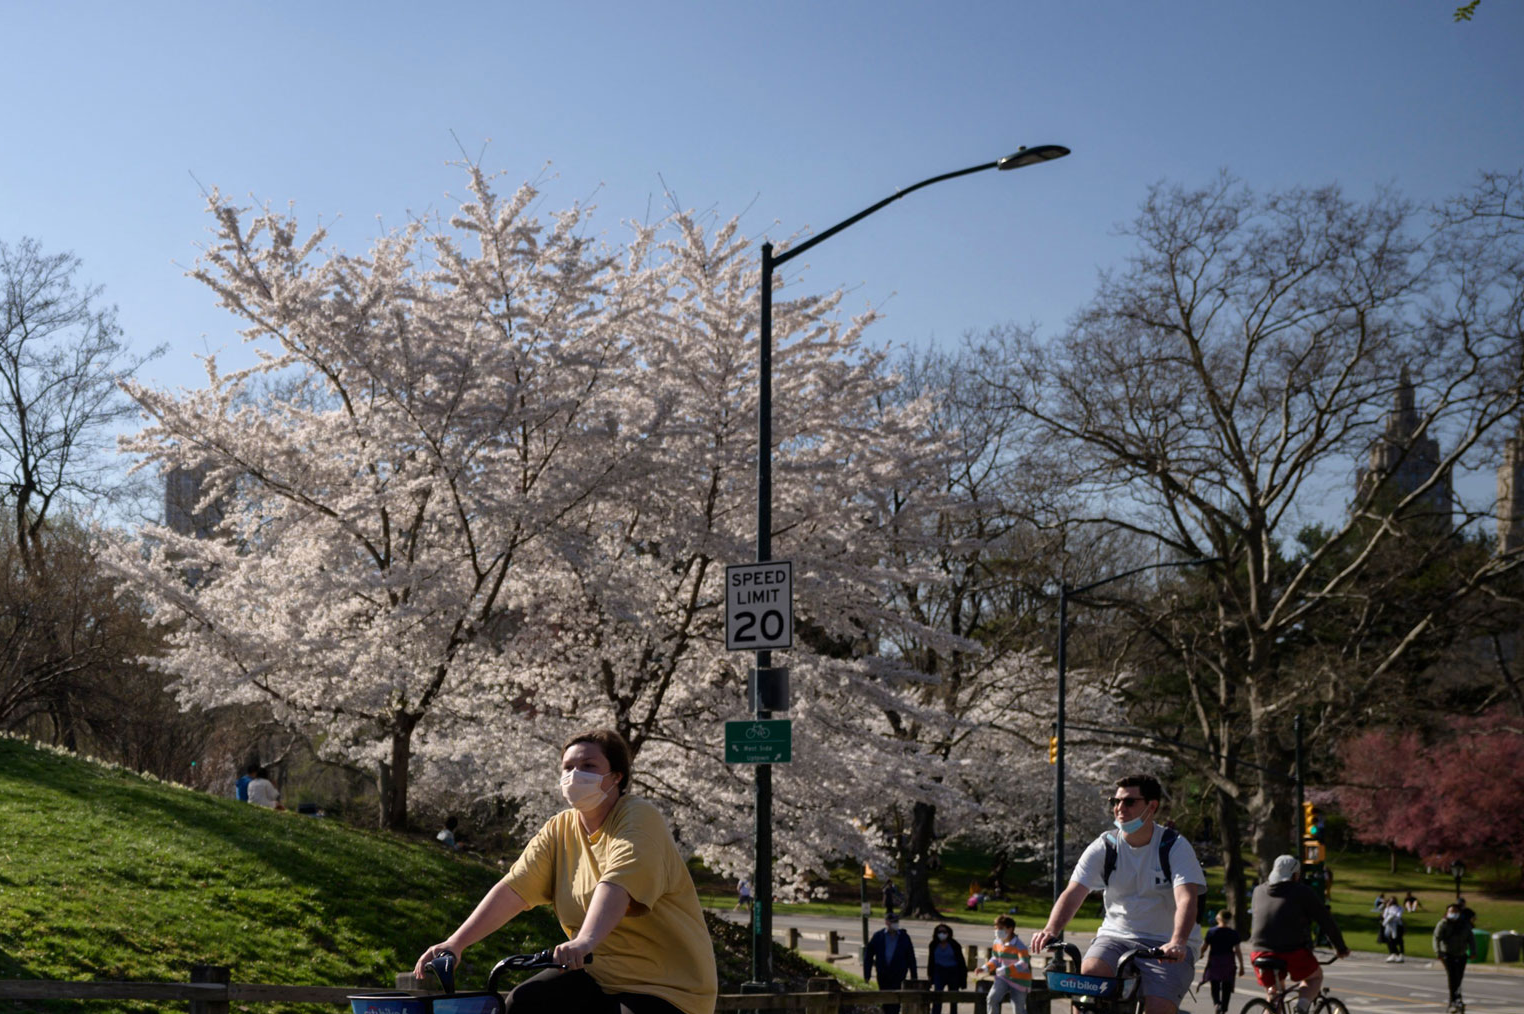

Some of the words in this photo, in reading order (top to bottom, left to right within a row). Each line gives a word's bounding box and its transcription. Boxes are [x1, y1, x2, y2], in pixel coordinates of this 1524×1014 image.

[732, 570, 786, 587] SPEED
[737, 588, 780, 605] LIMIT
[734, 609, 784, 642] 20
[1060, 978, 1076, 989] citi
[1077, 980, 1099, 991] bike
